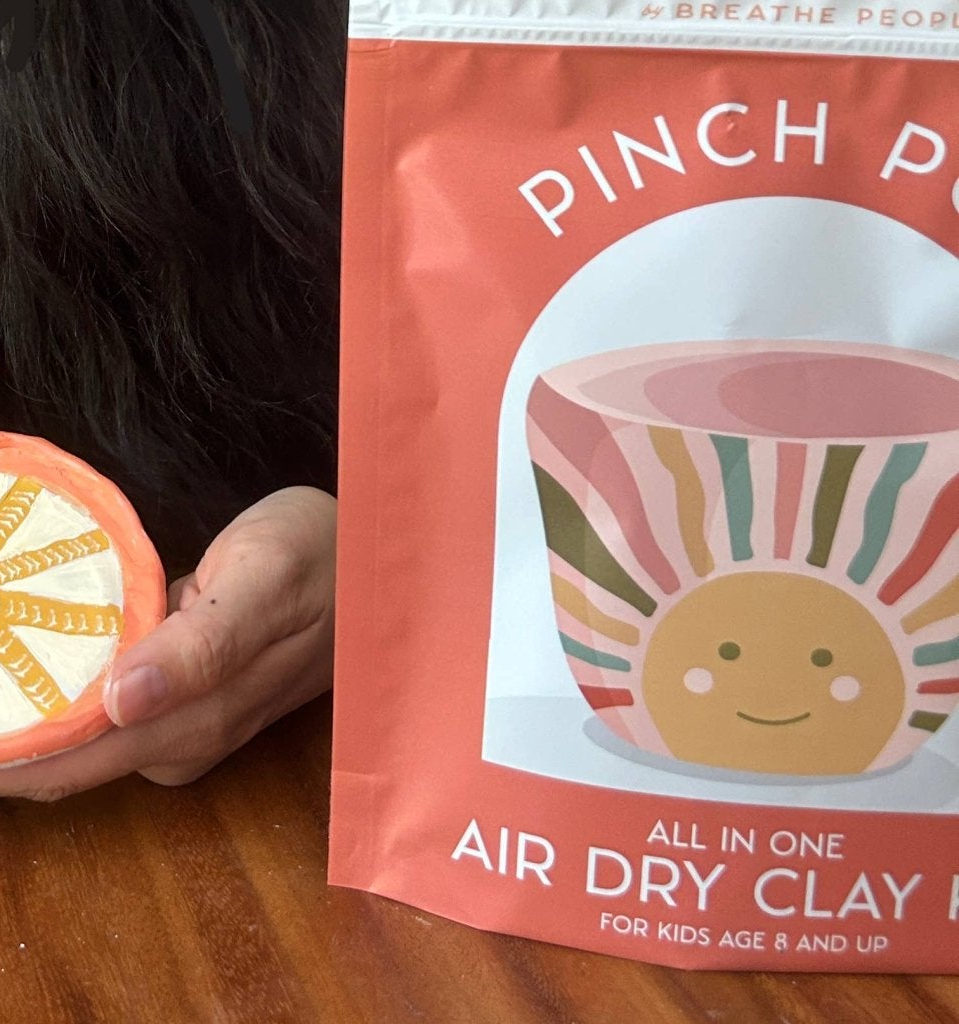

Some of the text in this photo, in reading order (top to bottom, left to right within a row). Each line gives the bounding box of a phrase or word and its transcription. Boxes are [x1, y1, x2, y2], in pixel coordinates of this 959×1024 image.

[641, 3, 665, 19] by
[675, 2, 837, 25] BREATHE
[517, 99, 830, 239] PINCH
[646, 818, 844, 859] ALL IN ONE
[450, 818, 556, 886] AIR
[585, 845, 726, 911] DRY
[753, 867, 923, 920] CLAY
[599, 912, 889, 953] FOR KIDS AGE 8 AND UP
